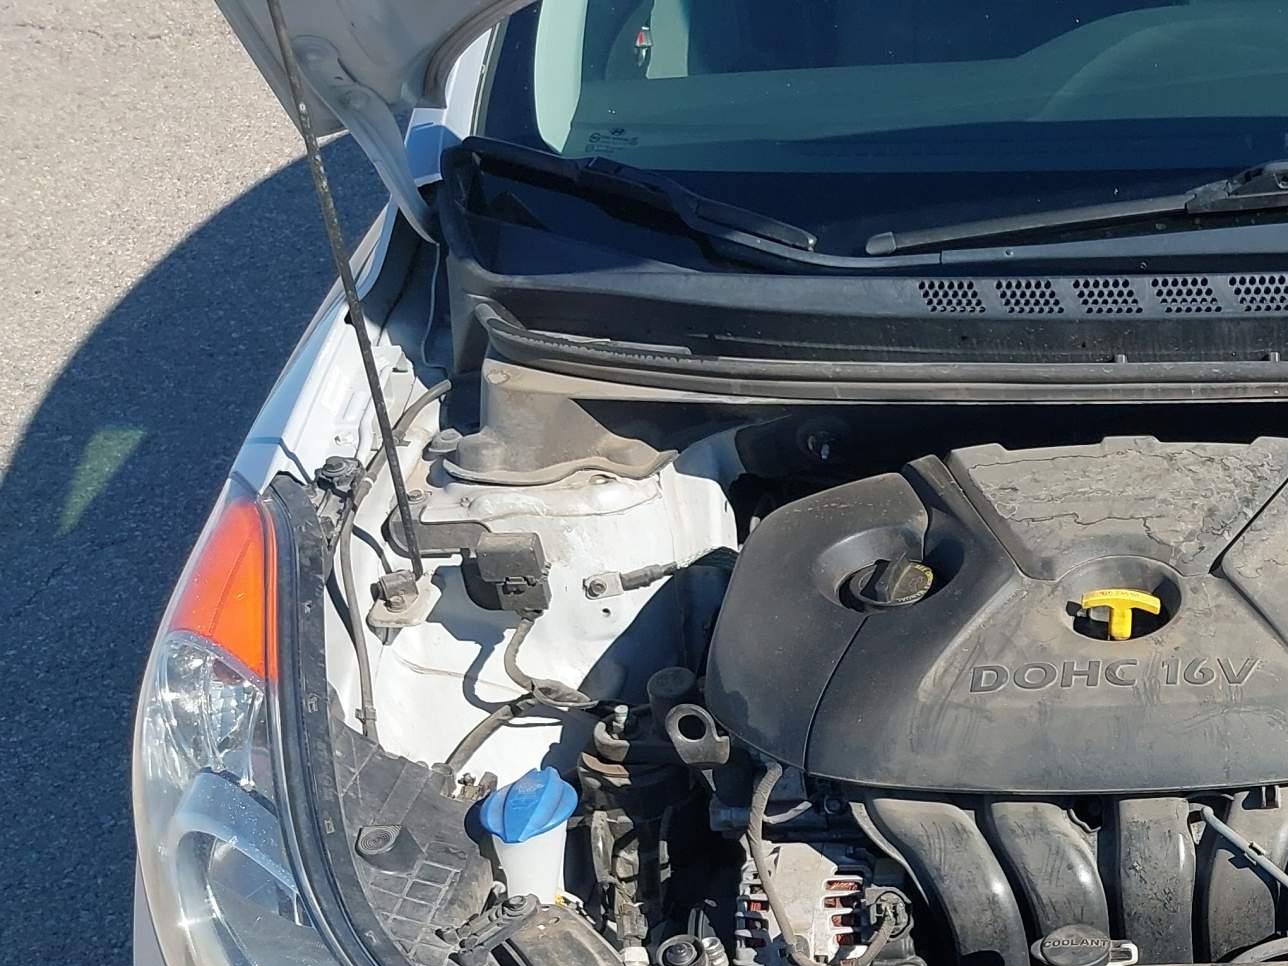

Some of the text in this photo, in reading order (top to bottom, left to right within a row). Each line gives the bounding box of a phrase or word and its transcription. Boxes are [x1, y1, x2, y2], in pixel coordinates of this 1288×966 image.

[969, 656, 1259, 694] DOHC 16V
[1043, 939, 1109, 948] COOLANT
